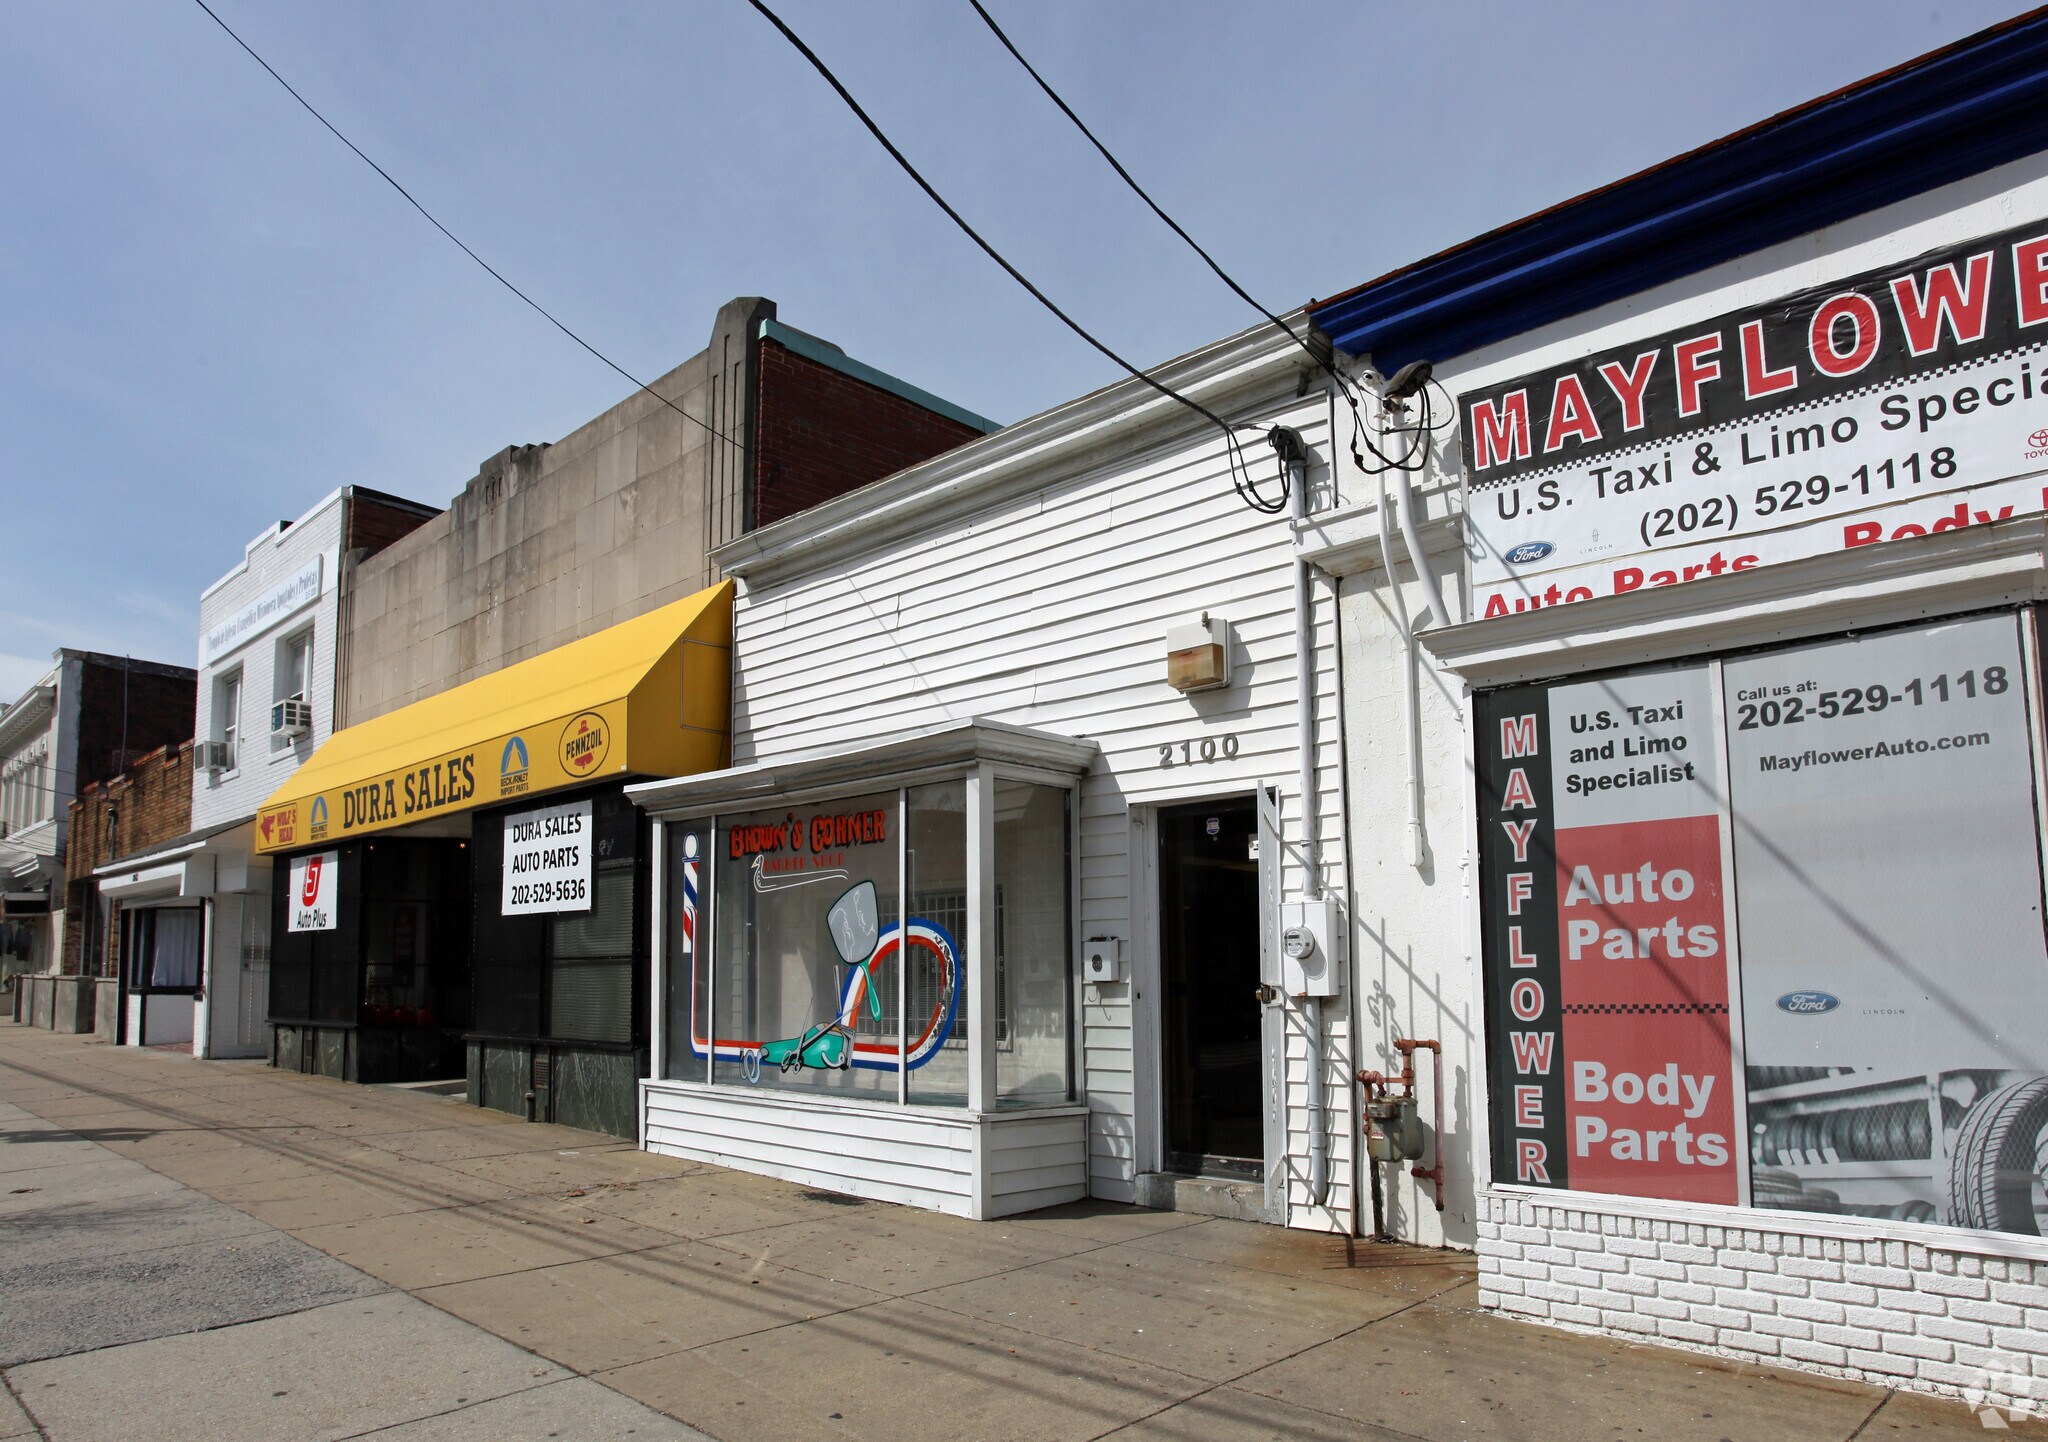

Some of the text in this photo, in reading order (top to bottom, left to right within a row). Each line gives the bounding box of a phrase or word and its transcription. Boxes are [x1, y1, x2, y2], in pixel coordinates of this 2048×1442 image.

[1497, 362, 2048, 520] U.S. Taxi & Limo Speci
[1639, 446, 1957, 547] (202) 529-1118
[1579, 544, 1613, 554] LINCOLN
[1737, 680, 1818, 702] Call us at:
[1737, 666, 2009, 731] 202-529-1118
[1570, 700, 1684, 733] U.S. Taxi
[565, 728, 603, 761] PENNZOIL
[1159, 733, 1239, 767] 2100
[1569, 735, 1688, 763] and Limo
[1759, 732, 1991, 771] MayflowerAuto.com
[343, 753, 475, 829] DURA SALES
[1566, 761, 1695, 796] Specialist
[513, 812, 582, 843] DURA SALES
[729, 809, 886, 860] BROWN'S CORNER
[512, 851, 540, 874] AUTO
[543, 846, 579, 869] PARTS
[511, 878, 586, 905] 202-529-5636
[1564, 861, 1695, 907] Auto
[297, 908, 327, 928] Auto Plus
[1500, 713, 1554, 1184] MAYFLOWER
[1567, 916, 1719, 960] Parts
[1573, 1061, 1716, 1118] Body
[1575, 1116, 1729, 1166] Parts
